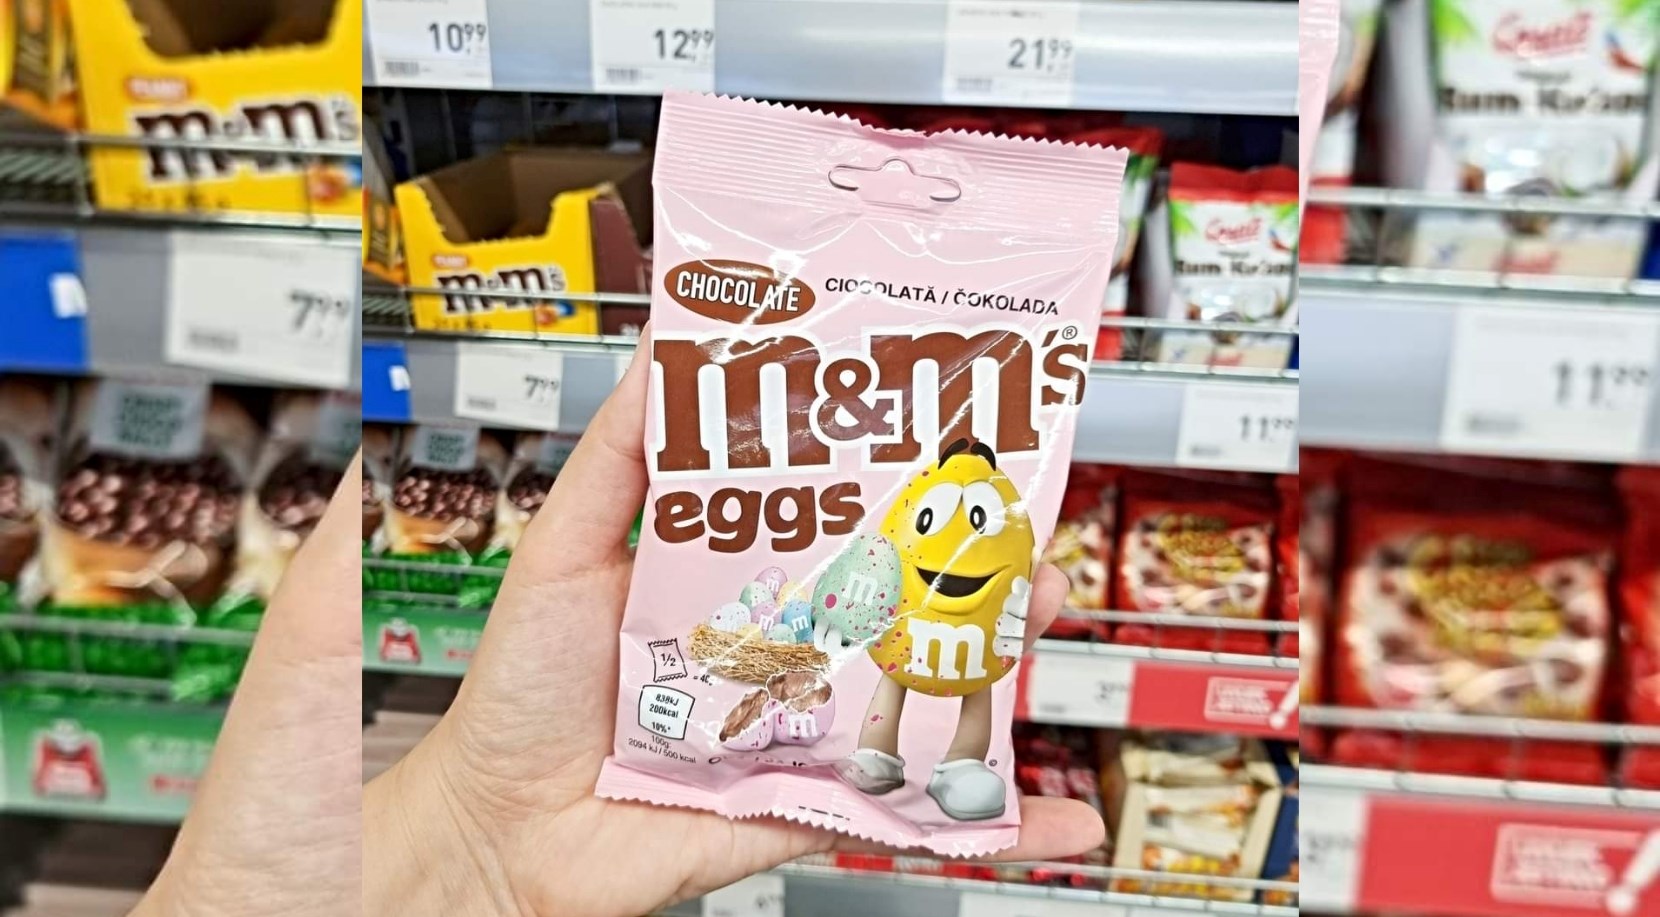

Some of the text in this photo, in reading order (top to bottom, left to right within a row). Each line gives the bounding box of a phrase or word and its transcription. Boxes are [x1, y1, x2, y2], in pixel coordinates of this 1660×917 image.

[675, 270, 801, 313] CHOCOLATE
[824, 277, 937, 304] CIOCOLATĂ
[953, 287, 1060, 316] ČOKOLADA
[654, 481, 867, 554] eggs
[840, 571, 879, 607] m
[660, 652, 677, 667] 1/2
[903, 617, 988, 681] m
[648, 703, 679, 719] 200kcal
[788, 710, 819, 739] m
[628, 737, 648, 750] 2094
[648, 743, 659, 754] kJ
[663, 748, 679, 760] 500
[679, 753, 697, 764] kcal
